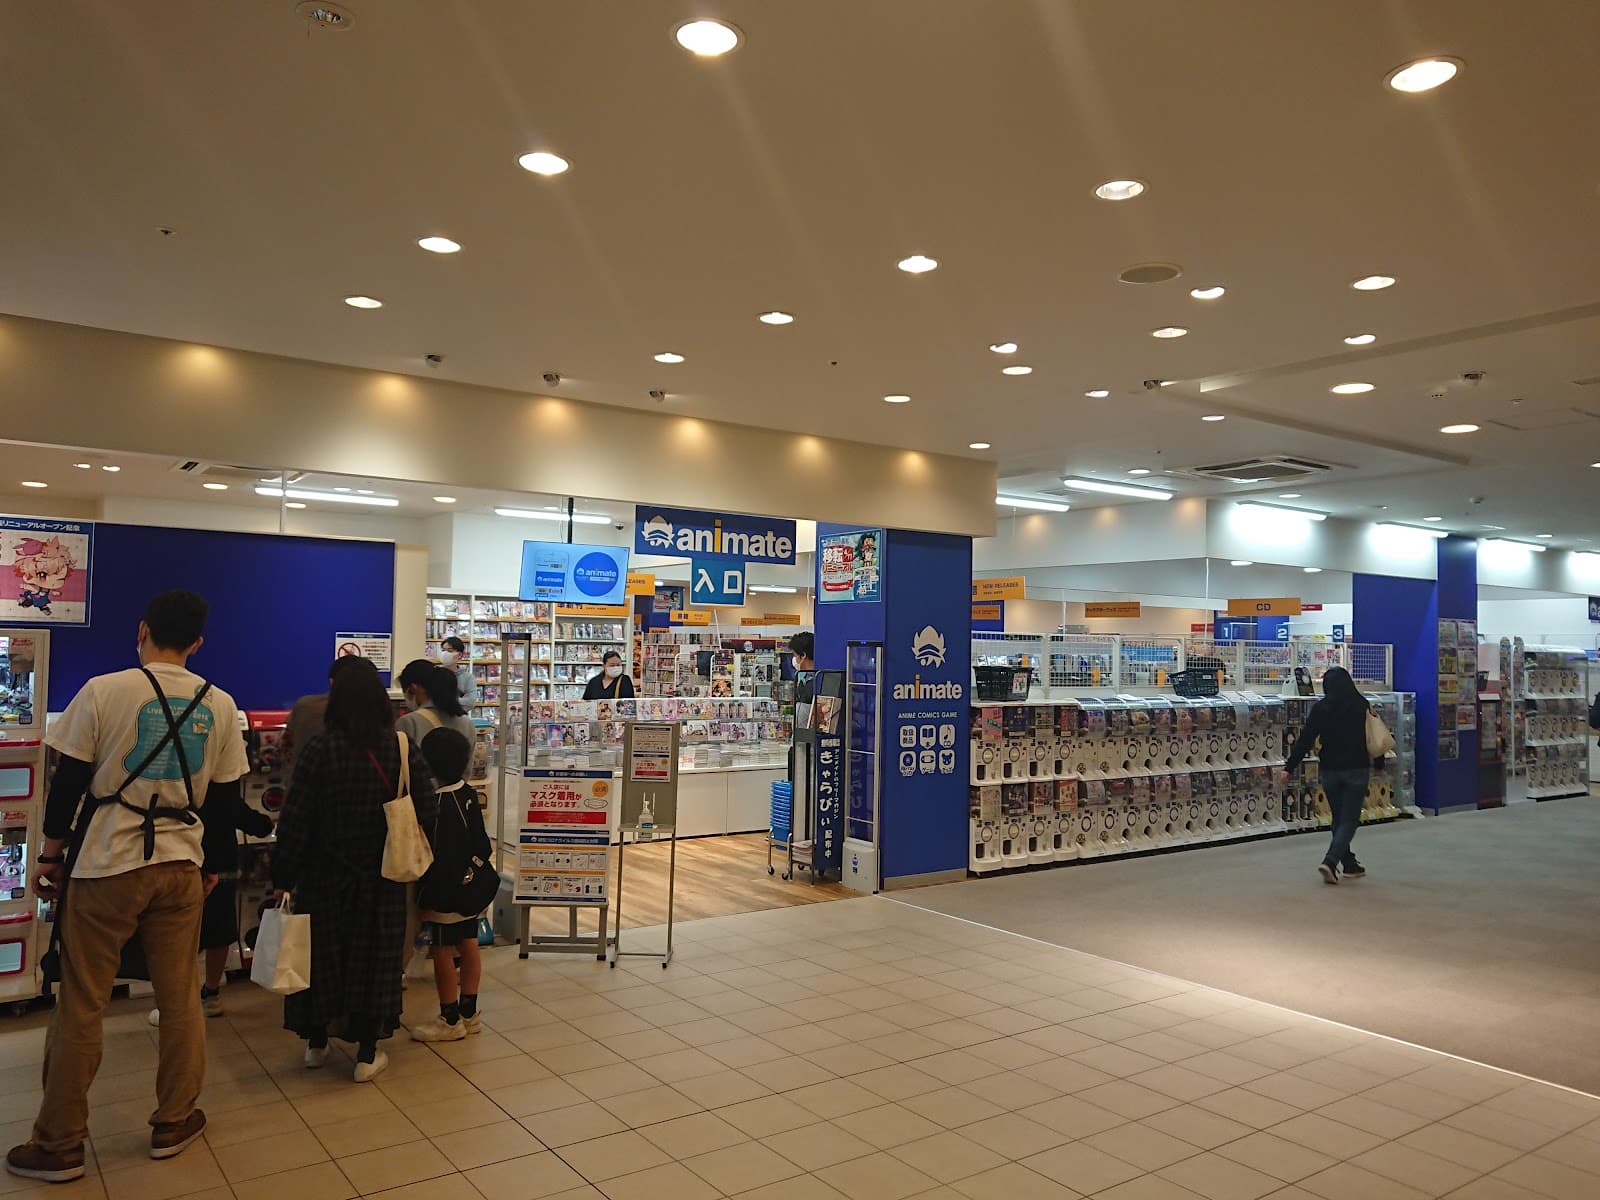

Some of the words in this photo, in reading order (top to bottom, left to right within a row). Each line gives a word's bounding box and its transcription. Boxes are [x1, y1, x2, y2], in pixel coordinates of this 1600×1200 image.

[676, 519, 792, 558] animate
[585, 567, 616, 577] animate
[694, 568, 742, 595] 入口
[1256, 603, 1271, 611] CD
[1223, 627, 1229, 638] 1
[1277, 628, 1288, 639] 2
[1334, 628, 1344, 640] 3
[893, 674, 962, 699] animate
[917, 711, 940, 719] COMICS
[530, 791, 582, 800] マスク着用が
